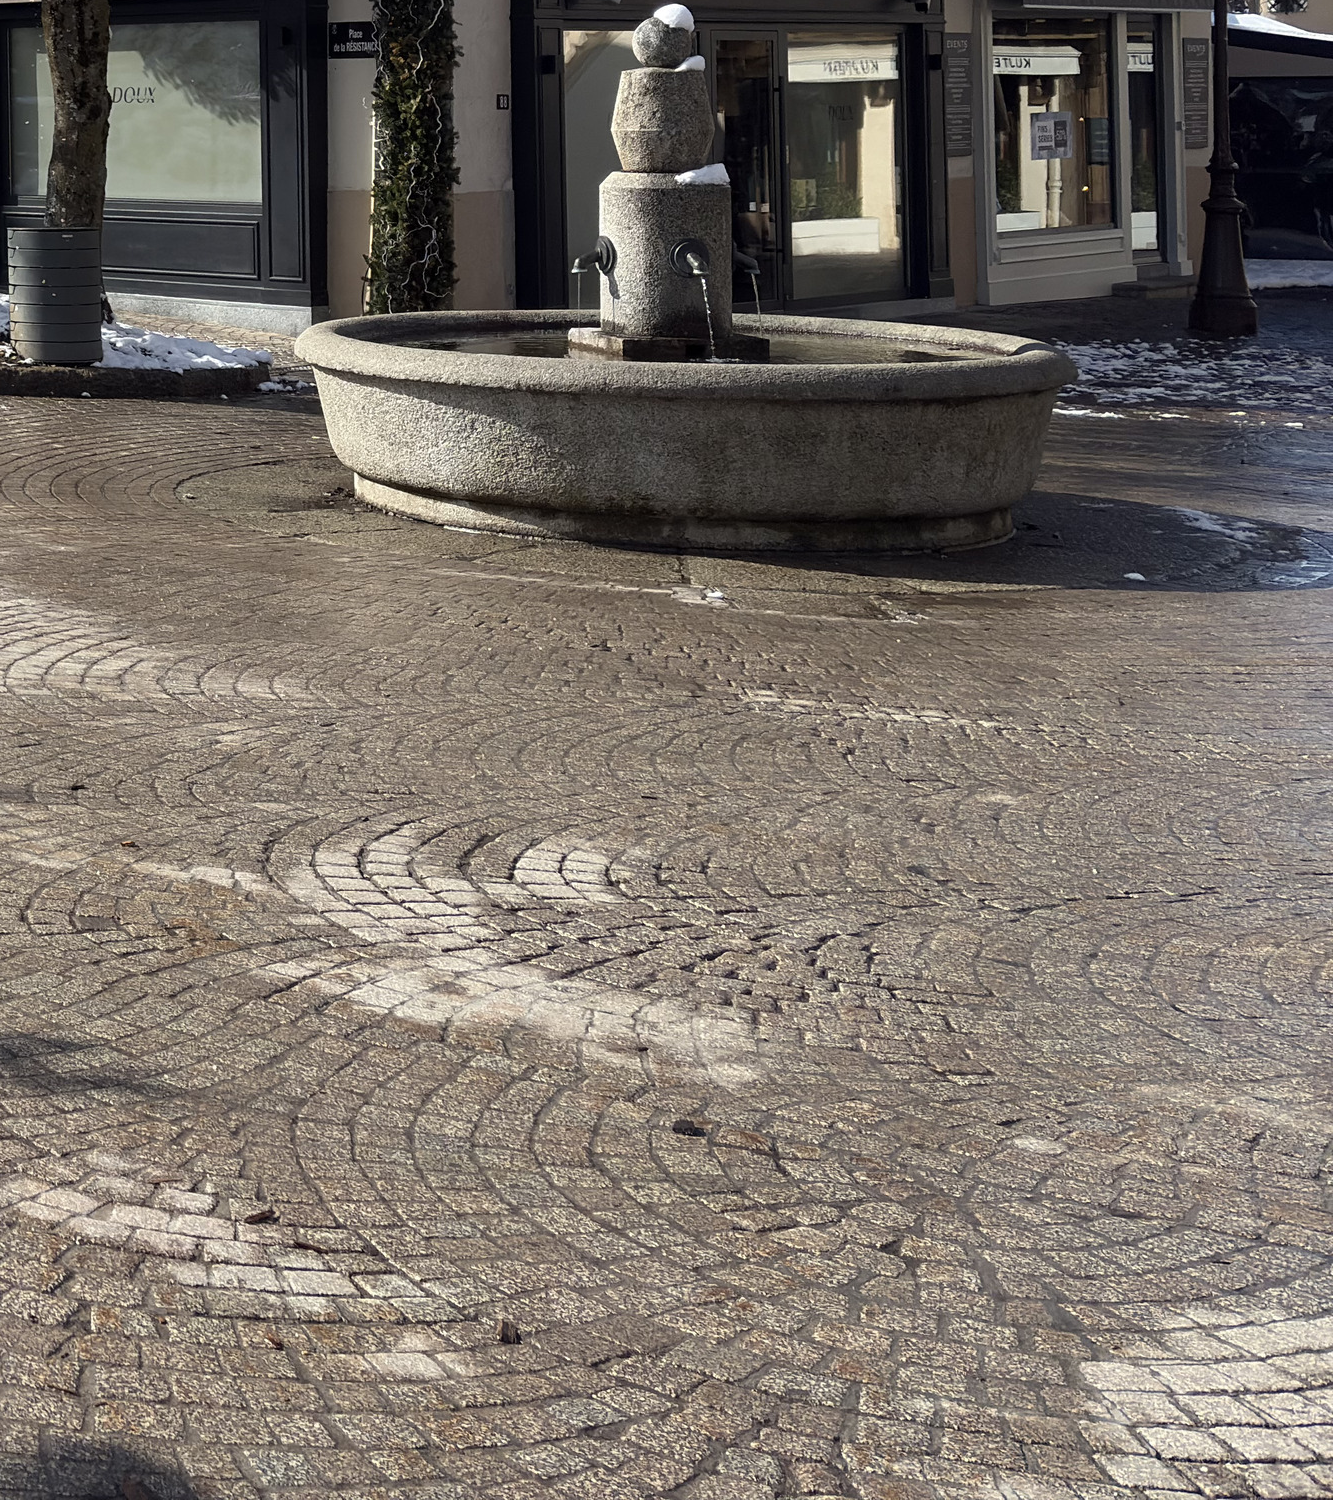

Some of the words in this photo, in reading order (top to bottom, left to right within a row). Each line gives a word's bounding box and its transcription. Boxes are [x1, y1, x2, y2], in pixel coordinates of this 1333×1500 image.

[348, 29, 363, 39] Place
[333, 43, 340, 52] de
[341, 43, 346, 52] la
[111, 86, 157, 104] DOUX
